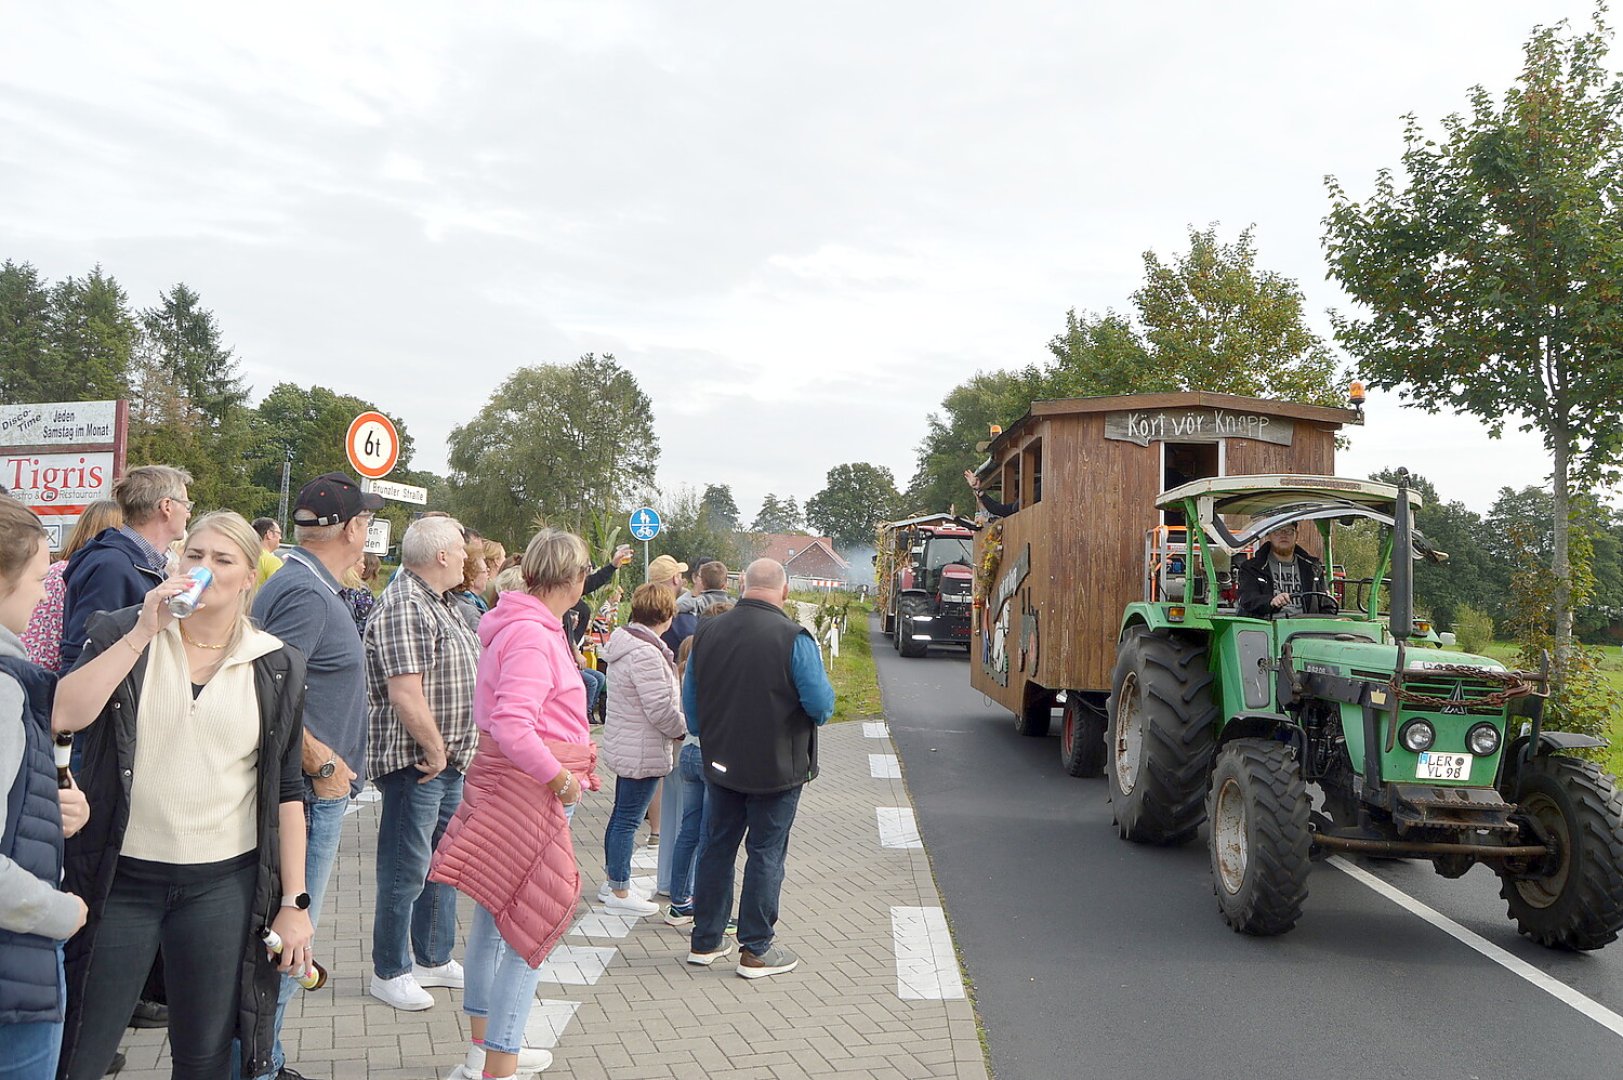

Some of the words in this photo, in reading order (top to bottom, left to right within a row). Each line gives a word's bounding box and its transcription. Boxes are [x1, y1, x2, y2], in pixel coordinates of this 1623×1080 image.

[2, 410, 31, 430] Disco-
[17, 415, 41, 432] Time
[53, 410, 75, 423] Jeden
[1128, 412, 1166, 437] Kört
[1171, 412, 1205, 436] vör
[43, 426, 74, 440] Samstag
[76, 425, 84, 436] im
[86, 424, 109, 436] Monat
[7, 457, 103, 502] Tigris
[59, 490, 101, 499] Restaurant
[403, 487, 424, 501] Straße
[368, 527, 382, 535] en-
[365, 539, 381, 548] den
[1428, 755, 1452, 766] LER
[1428, 765, 1442, 778] YL
[1446, 767, 1462, 779] 98
